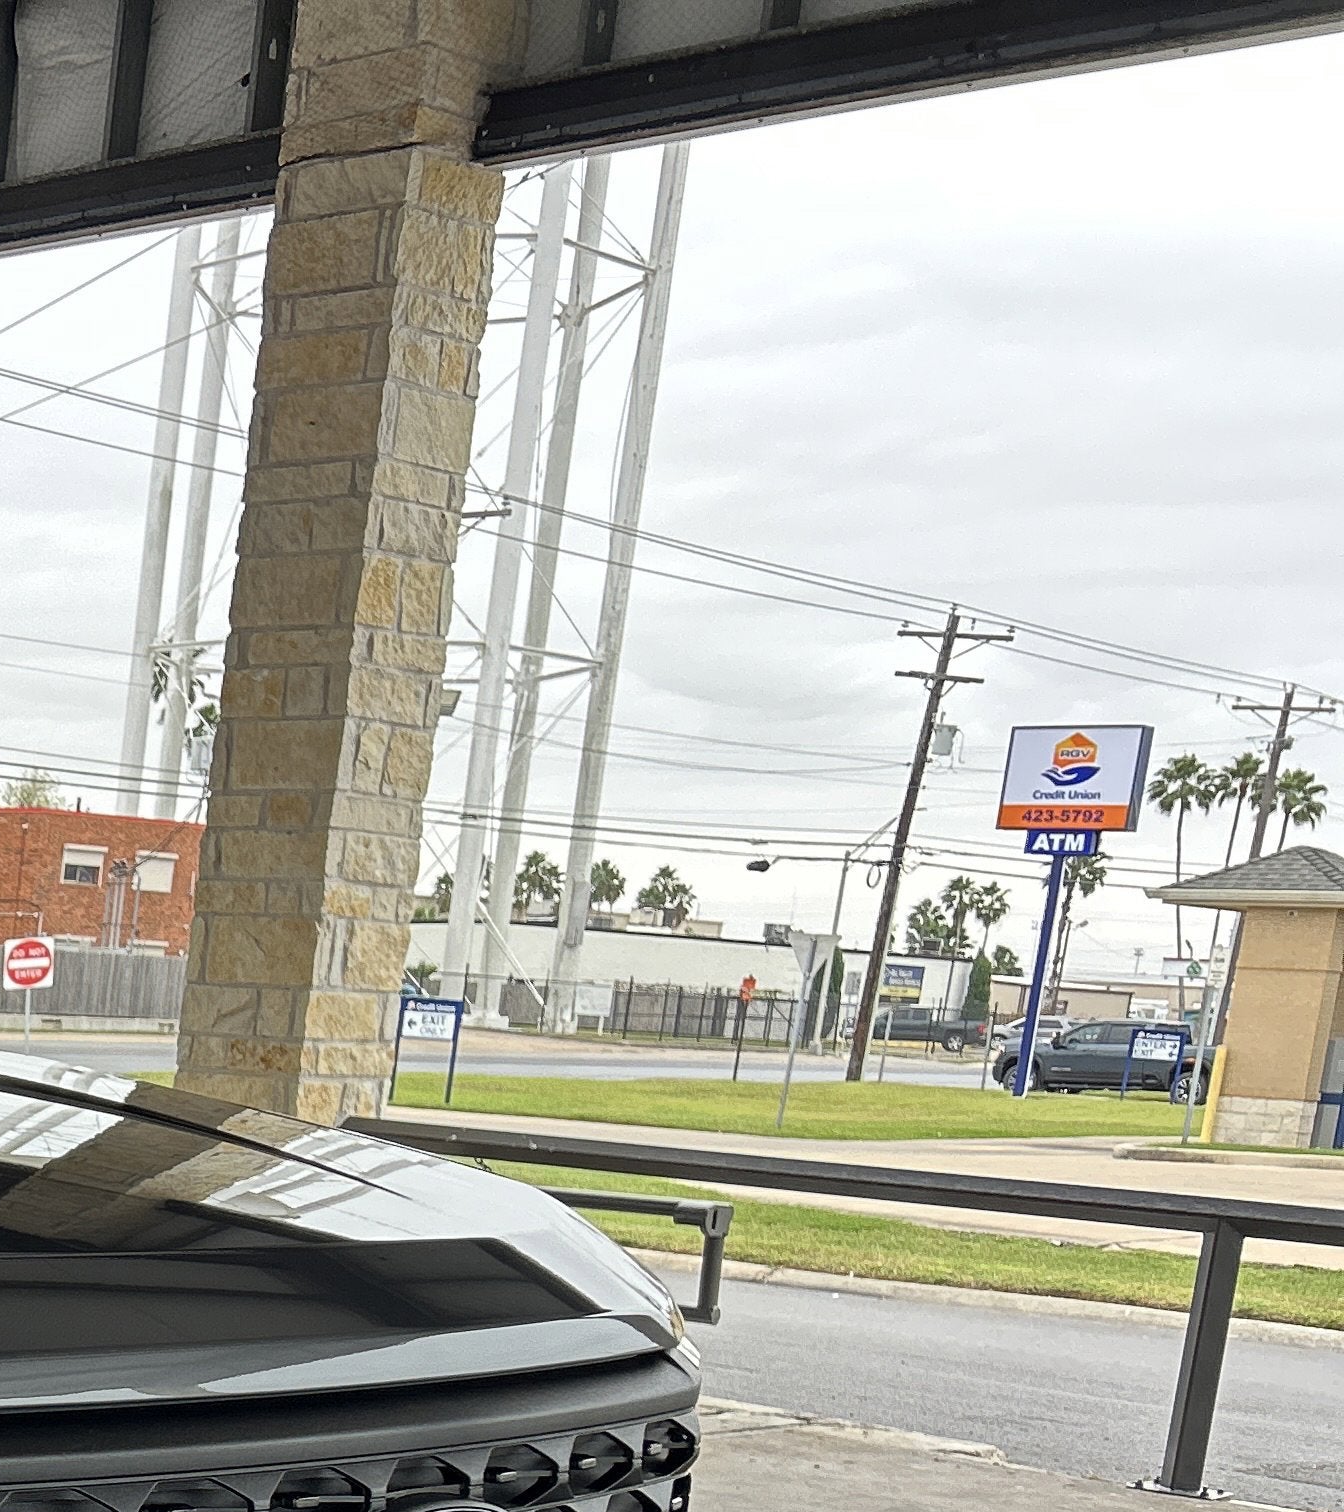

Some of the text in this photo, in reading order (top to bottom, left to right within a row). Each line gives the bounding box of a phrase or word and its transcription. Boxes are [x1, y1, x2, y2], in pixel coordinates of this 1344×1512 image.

[1032, 789, 1101, 800] Credit Union
[1021, 809, 1105, 823] 423-5792
[1031, 833, 1086, 851] ATM
